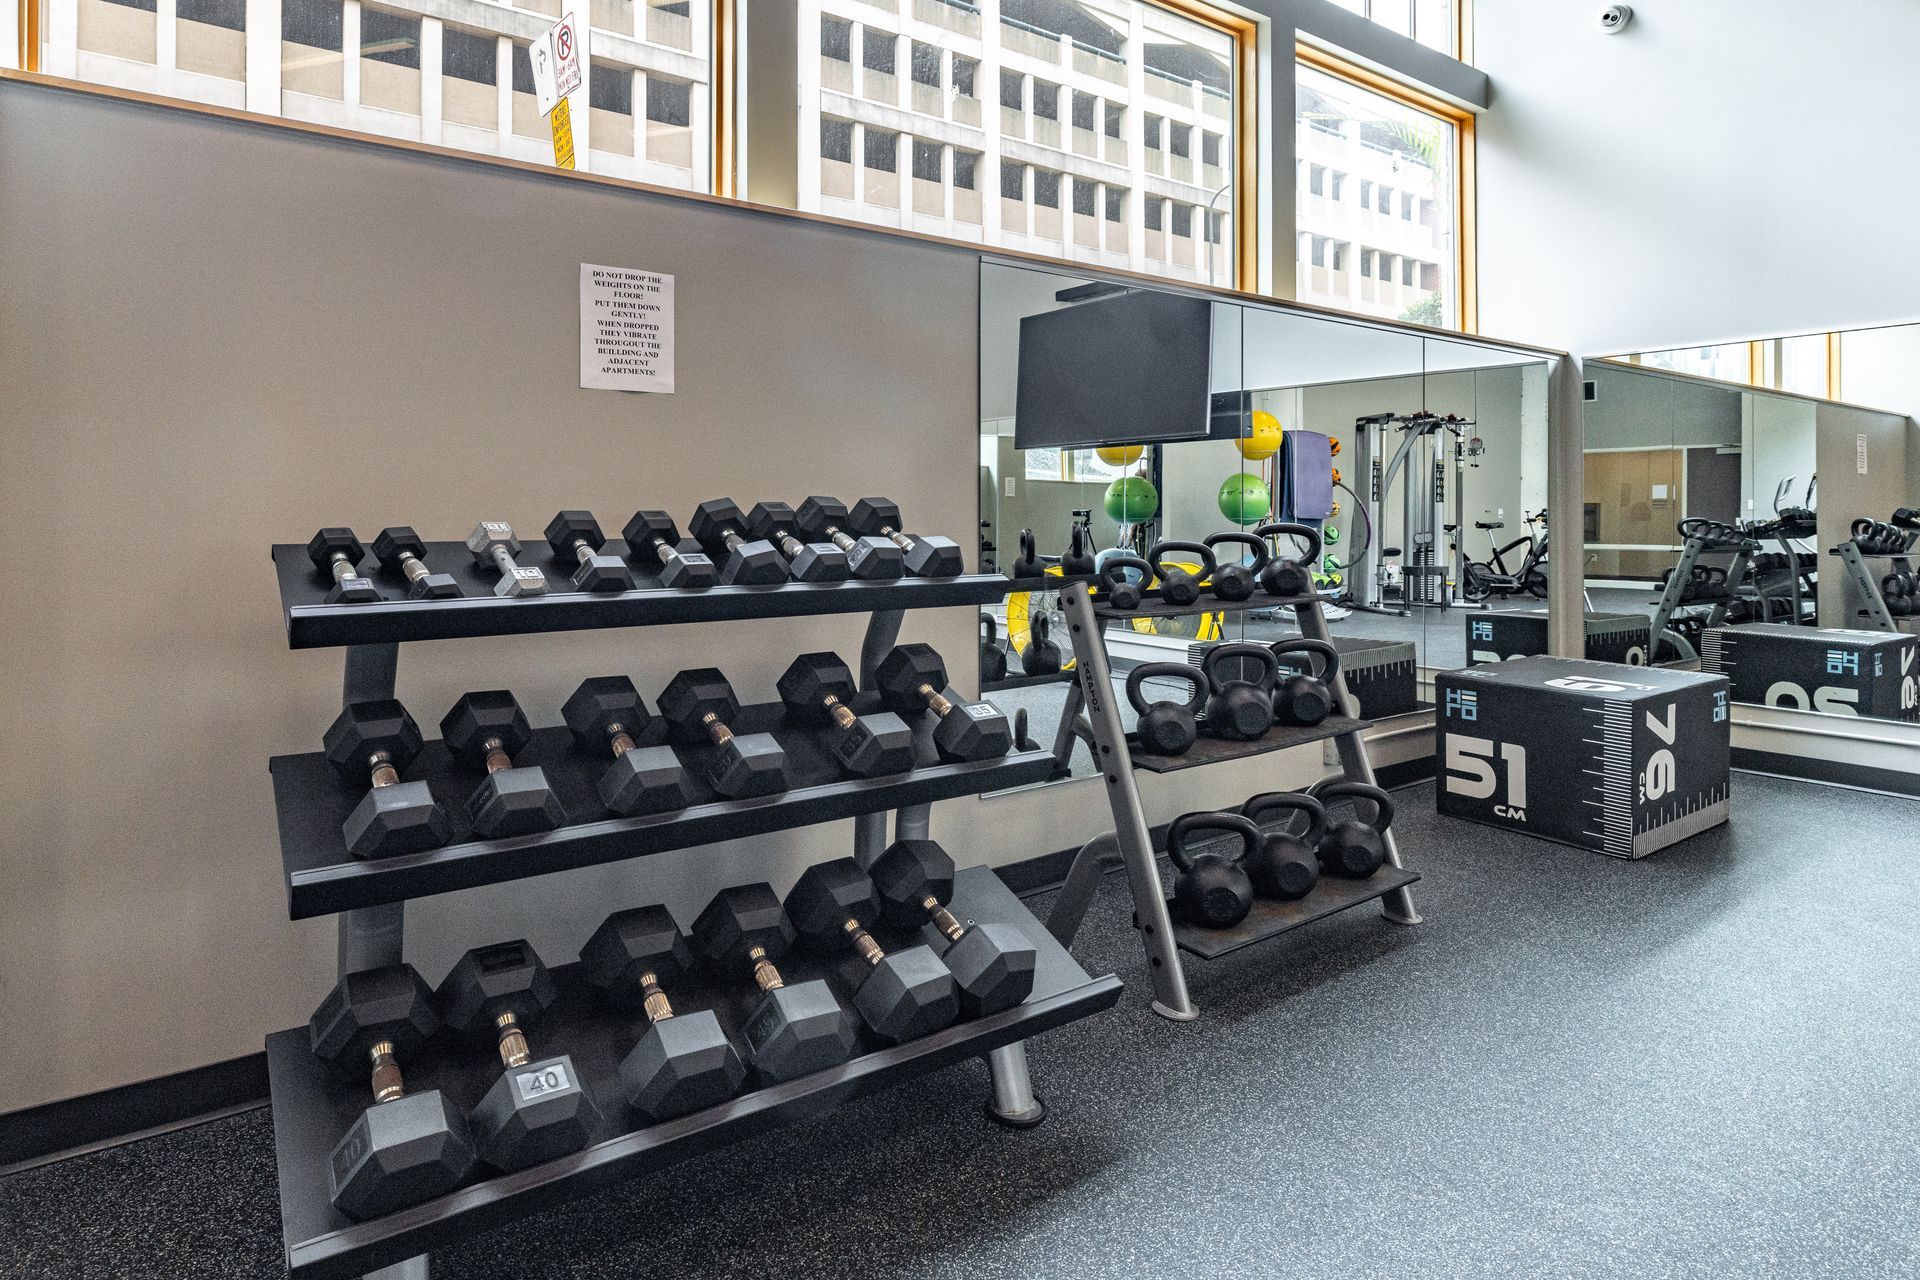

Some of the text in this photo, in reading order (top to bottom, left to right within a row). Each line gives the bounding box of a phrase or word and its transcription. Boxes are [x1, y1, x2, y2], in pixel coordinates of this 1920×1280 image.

[594, 280, 631, 289] WEIGHTS
[647, 276, 662, 284] THE
[612, 301, 635, 309] THEM
[611, 311, 645, 319] GENTLY!
[624, 322, 659, 331] DROPPED
[624, 331, 656, 340] VIBRATE
[594, 339, 645, 348] THROUGOUT
[601, 367, 656, 376] APARTMENTS!
[1083, 661, 1100, 712] HAMPTON
[972, 705, 991, 715] 35
[1646, 703, 1676, 800] 76
[1446, 733, 1526, 809] 51
[1640, 772, 1645, 805] CM
[1494, 805, 1526, 822] CM
[531, 1071, 559, 1091] 40
